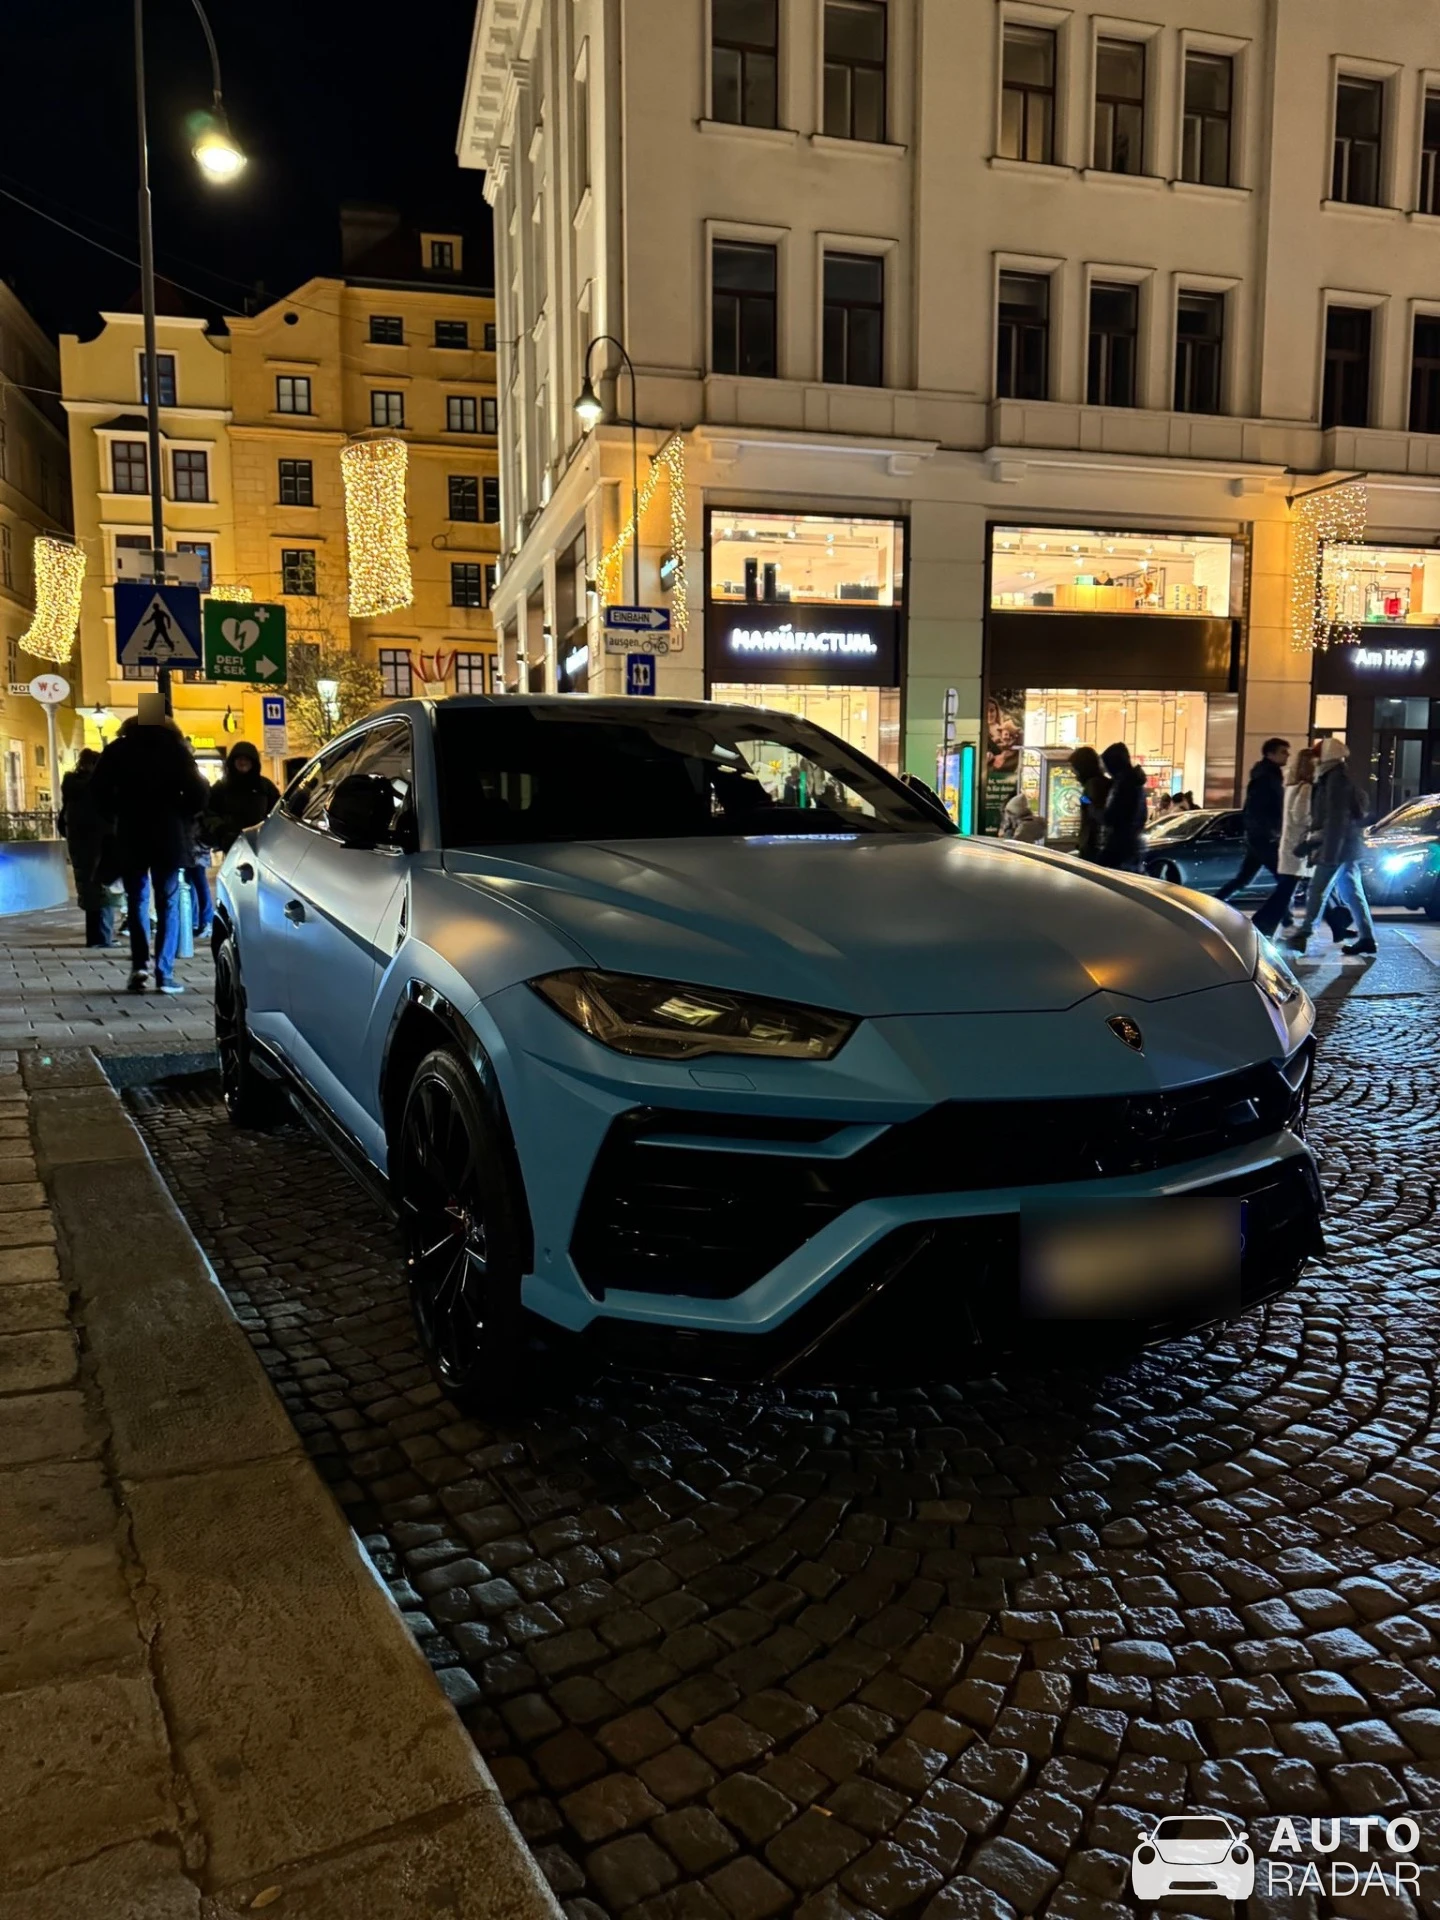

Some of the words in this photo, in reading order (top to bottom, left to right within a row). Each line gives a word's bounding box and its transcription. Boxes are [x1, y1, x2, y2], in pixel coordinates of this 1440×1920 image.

[613, 611, 650, 622] EINBAHN
[216, 655, 243, 665] DEFI
[1355, 648, 1382, 666] Am
[1385, 649, 1413, 667] Hof
[1414, 649, 1425, 667] 3
[223, 665, 246, 675] SEK
